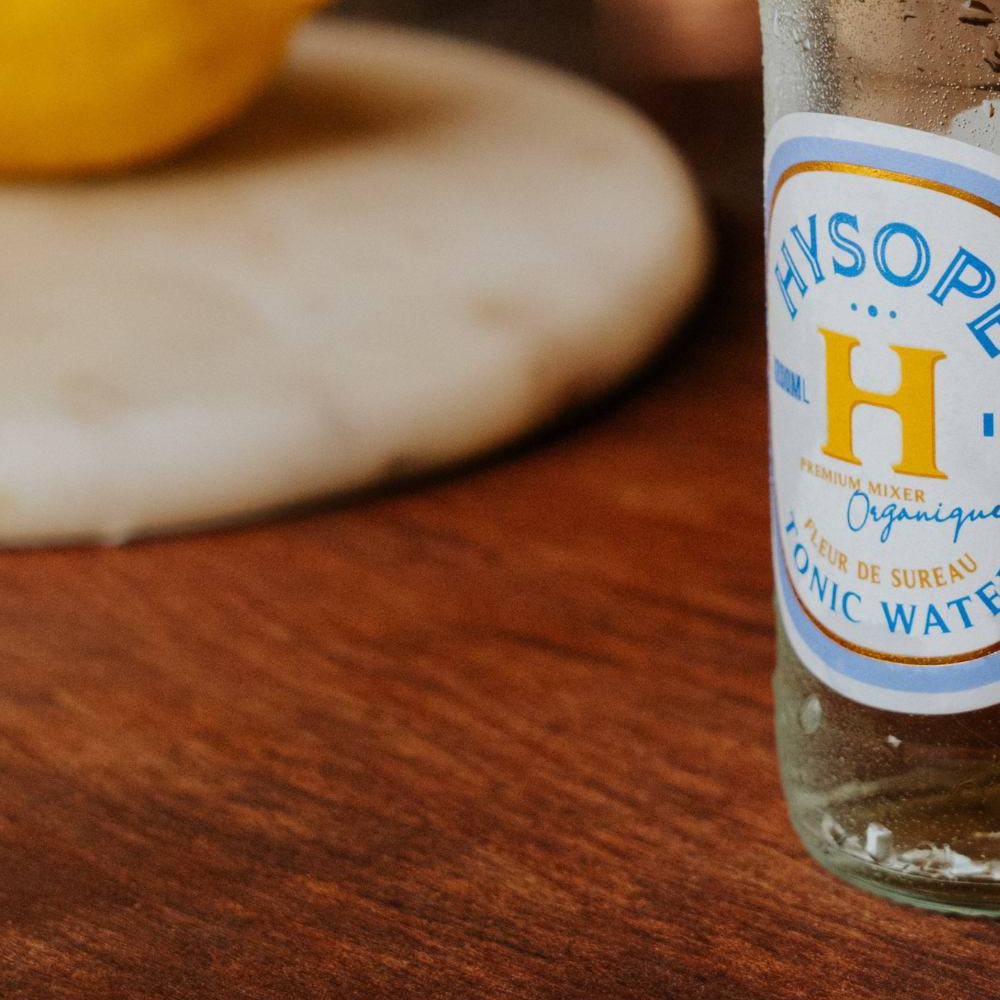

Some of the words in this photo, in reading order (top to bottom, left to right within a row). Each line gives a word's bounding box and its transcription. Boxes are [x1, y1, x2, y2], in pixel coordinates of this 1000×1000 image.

[817, 325, 949, 480] H
[800, 457, 861, 491] PREMIUM
[868, 480, 926, 503] MIXER
[785, 511, 862, 624] TONIC
[804, 518, 848, 574] FLEUR
[857, 560, 881, 584] DE
[891, 552, 978, 589] SUREAU
